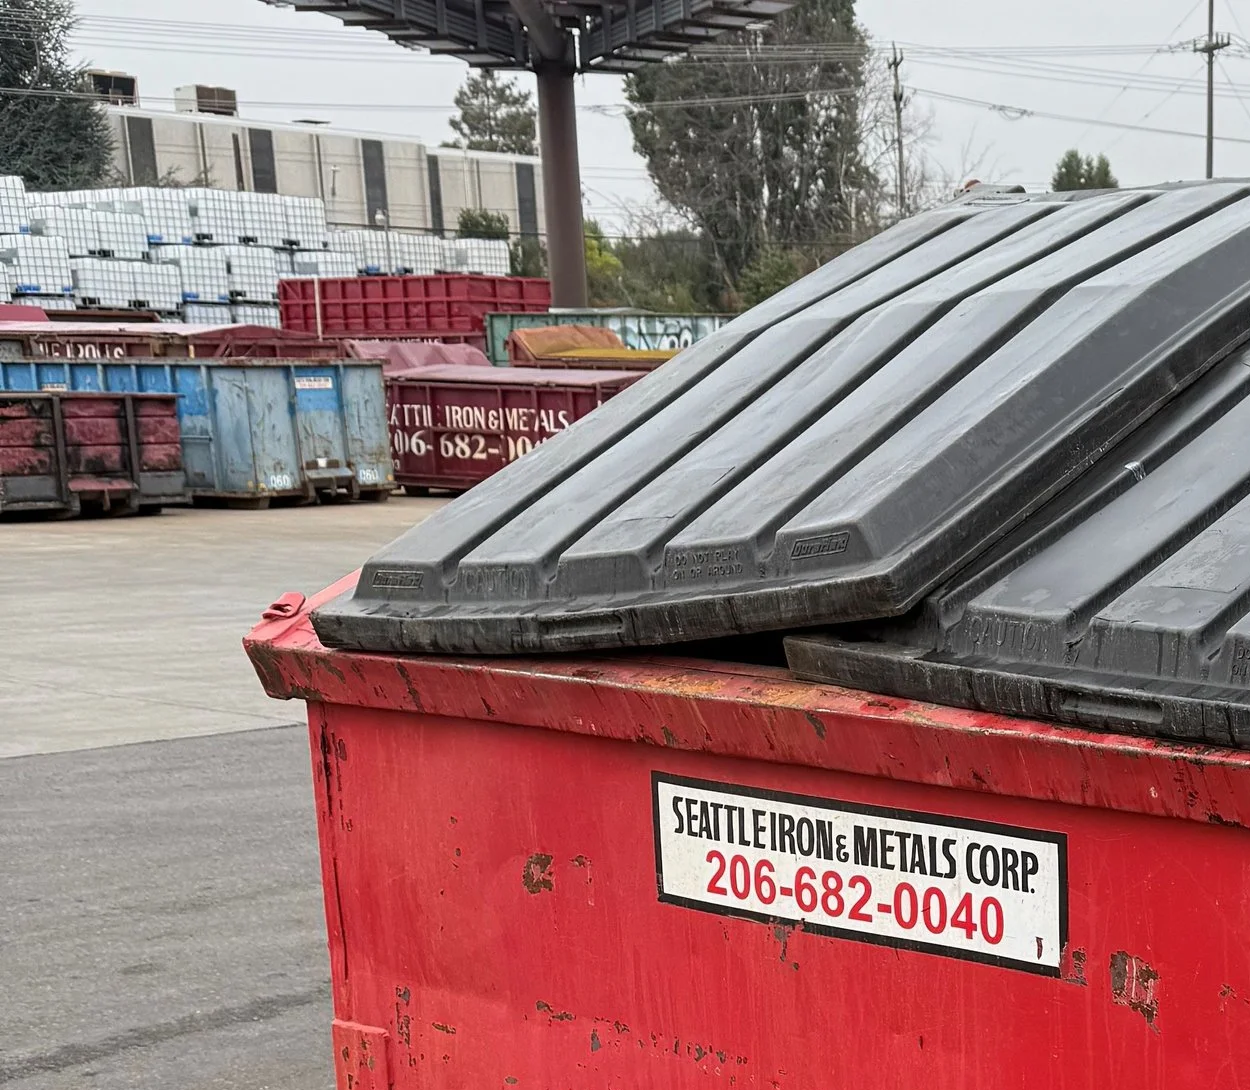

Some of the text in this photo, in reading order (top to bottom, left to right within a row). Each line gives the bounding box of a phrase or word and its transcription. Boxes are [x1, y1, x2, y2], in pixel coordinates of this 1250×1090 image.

[445, 405, 486, 430] IRON
[488, 409, 499, 431] &
[499, 407, 570, 433] MEALS
[674, 549, 739, 566] DO NOT PLAY
[672, 563, 743, 581] ON OR AROUND
[1231, 664, 1248, 677] ON
[672, 795, 766, 850] SEATTLE
[769, 811, 834, 861] IRON
[853, 825, 957, 880] METALS
[965, 842, 1039, 894] CORP.
[705, 849, 1005, 945] 206-682-0040
